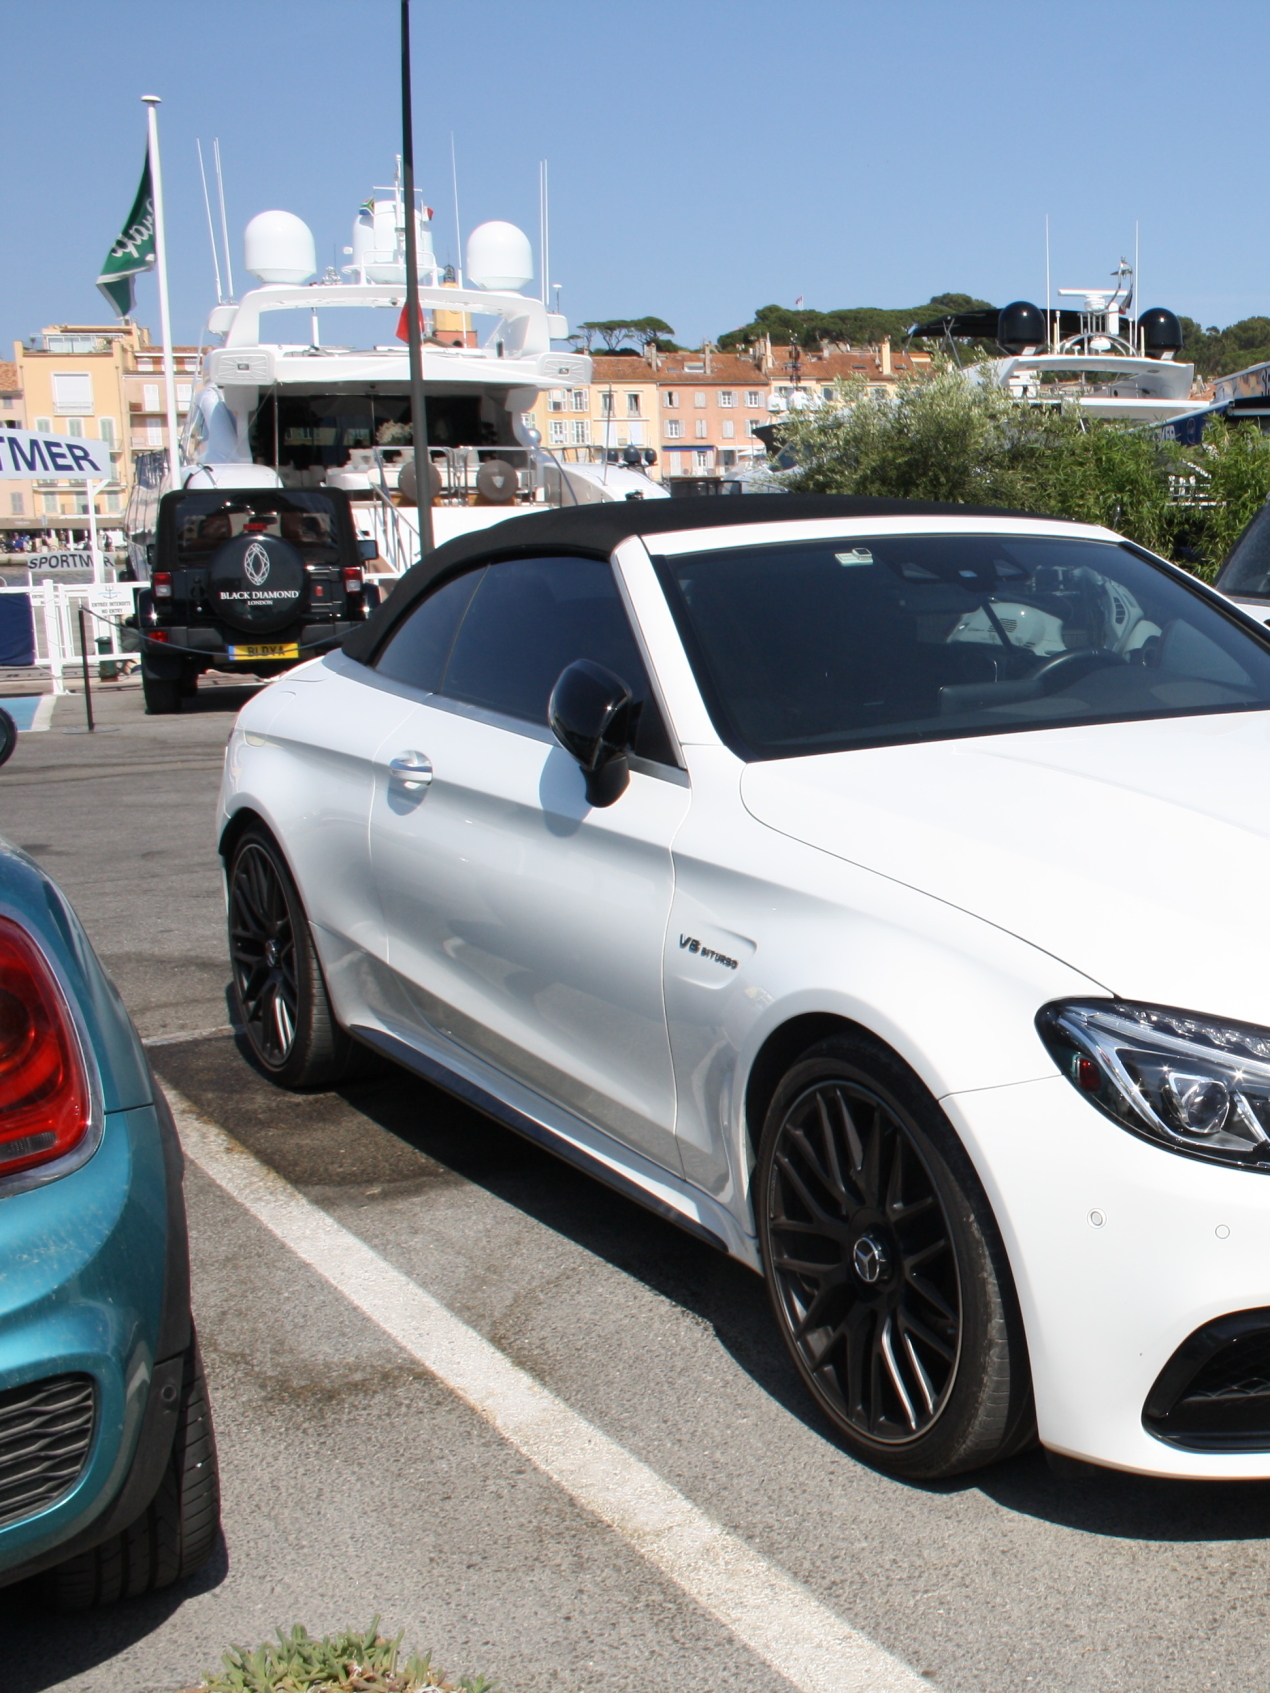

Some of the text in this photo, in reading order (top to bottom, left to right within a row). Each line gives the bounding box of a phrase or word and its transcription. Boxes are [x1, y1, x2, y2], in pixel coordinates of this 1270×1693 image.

[28, 554, 114, 570] SPORTMR
[220, 590, 299, 600] BLACK DIAMOND
[701, 947, 738, 970] BITURBO
